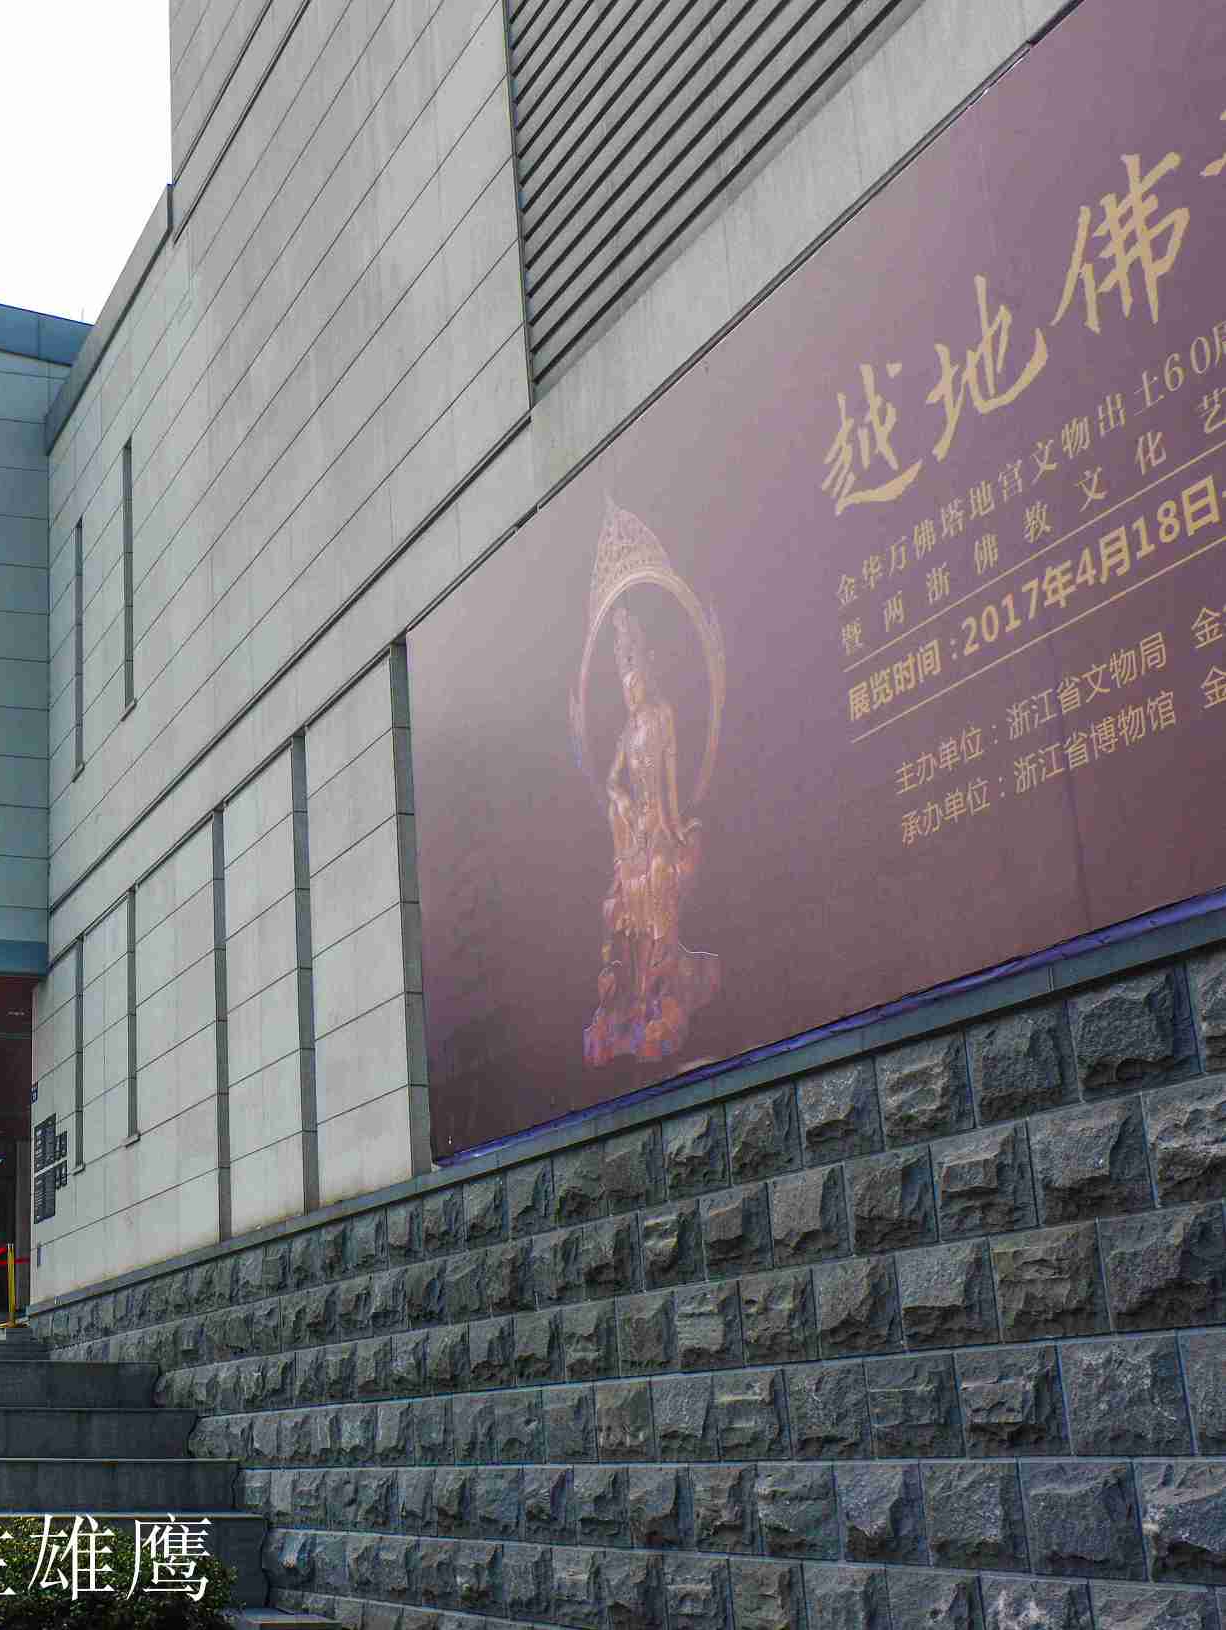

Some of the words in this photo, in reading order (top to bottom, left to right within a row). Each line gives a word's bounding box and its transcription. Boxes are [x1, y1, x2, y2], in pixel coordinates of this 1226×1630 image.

[821, 110, 1226, 517] 越地佛
[848, 474, 1226, 722] 展览时间：2017年4月18日
